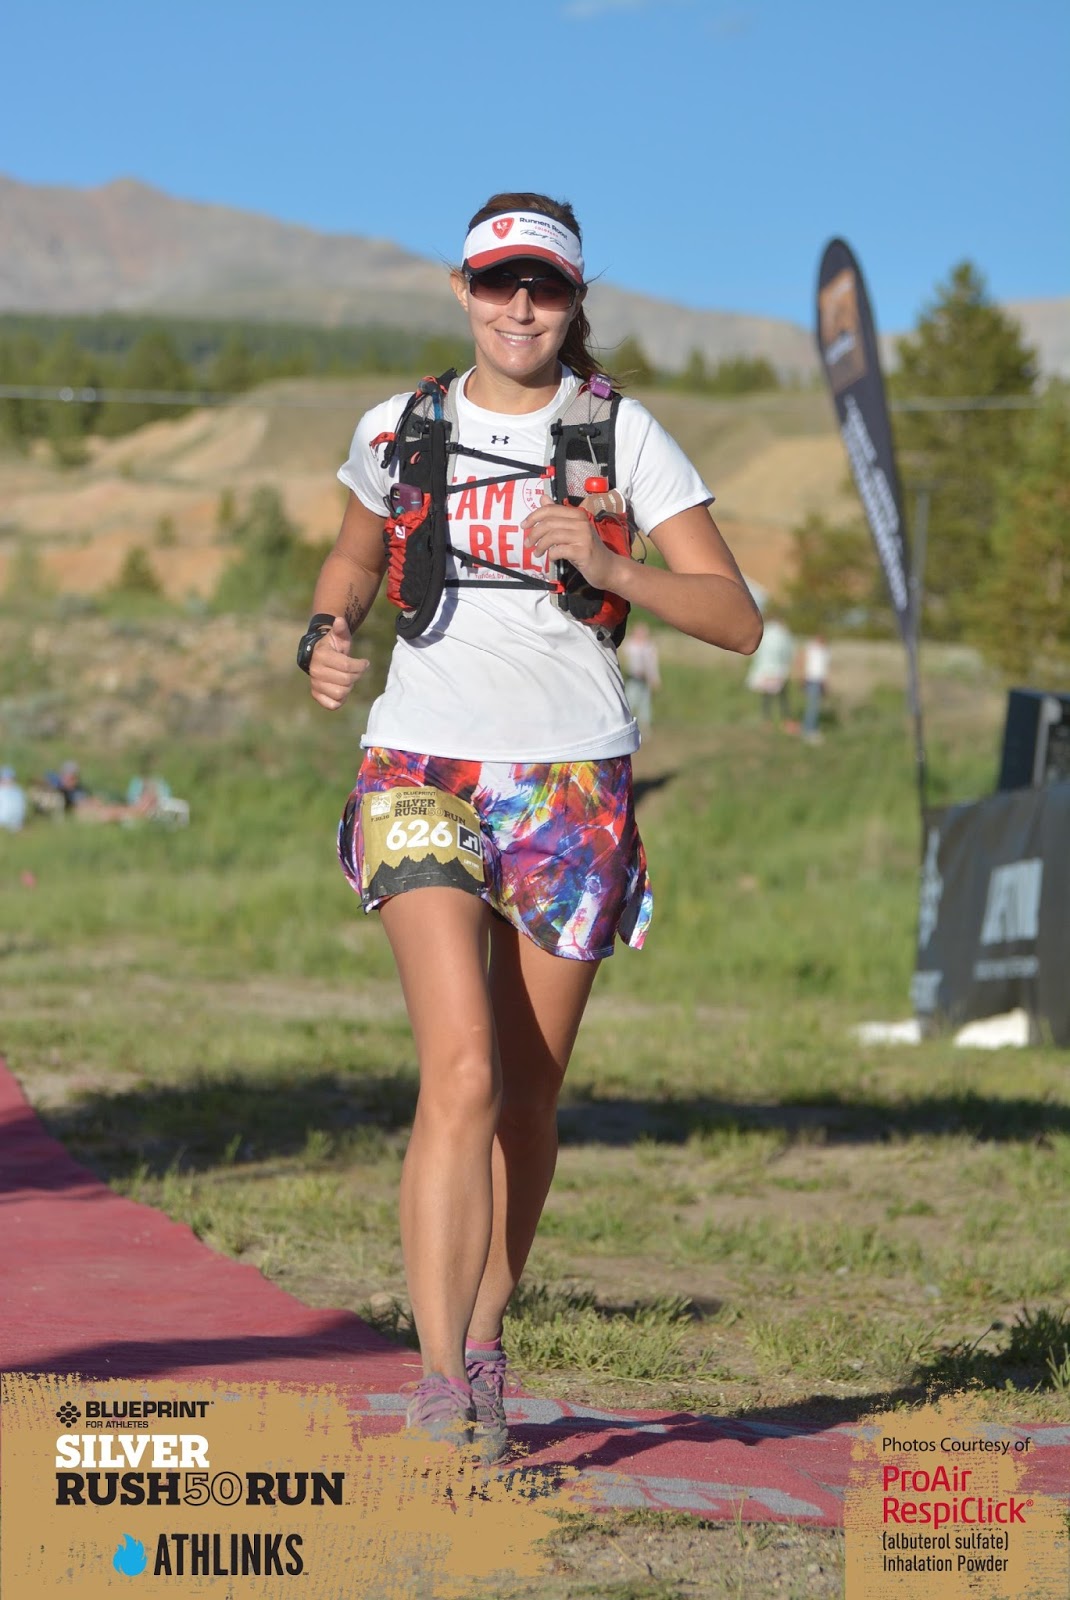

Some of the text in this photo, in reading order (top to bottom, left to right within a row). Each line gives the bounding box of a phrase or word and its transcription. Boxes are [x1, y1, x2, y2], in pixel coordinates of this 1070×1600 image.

[519, 217, 551, 229] Runners
[395, 798, 435, 809] SILVER
[386, 819, 453, 851] 626
